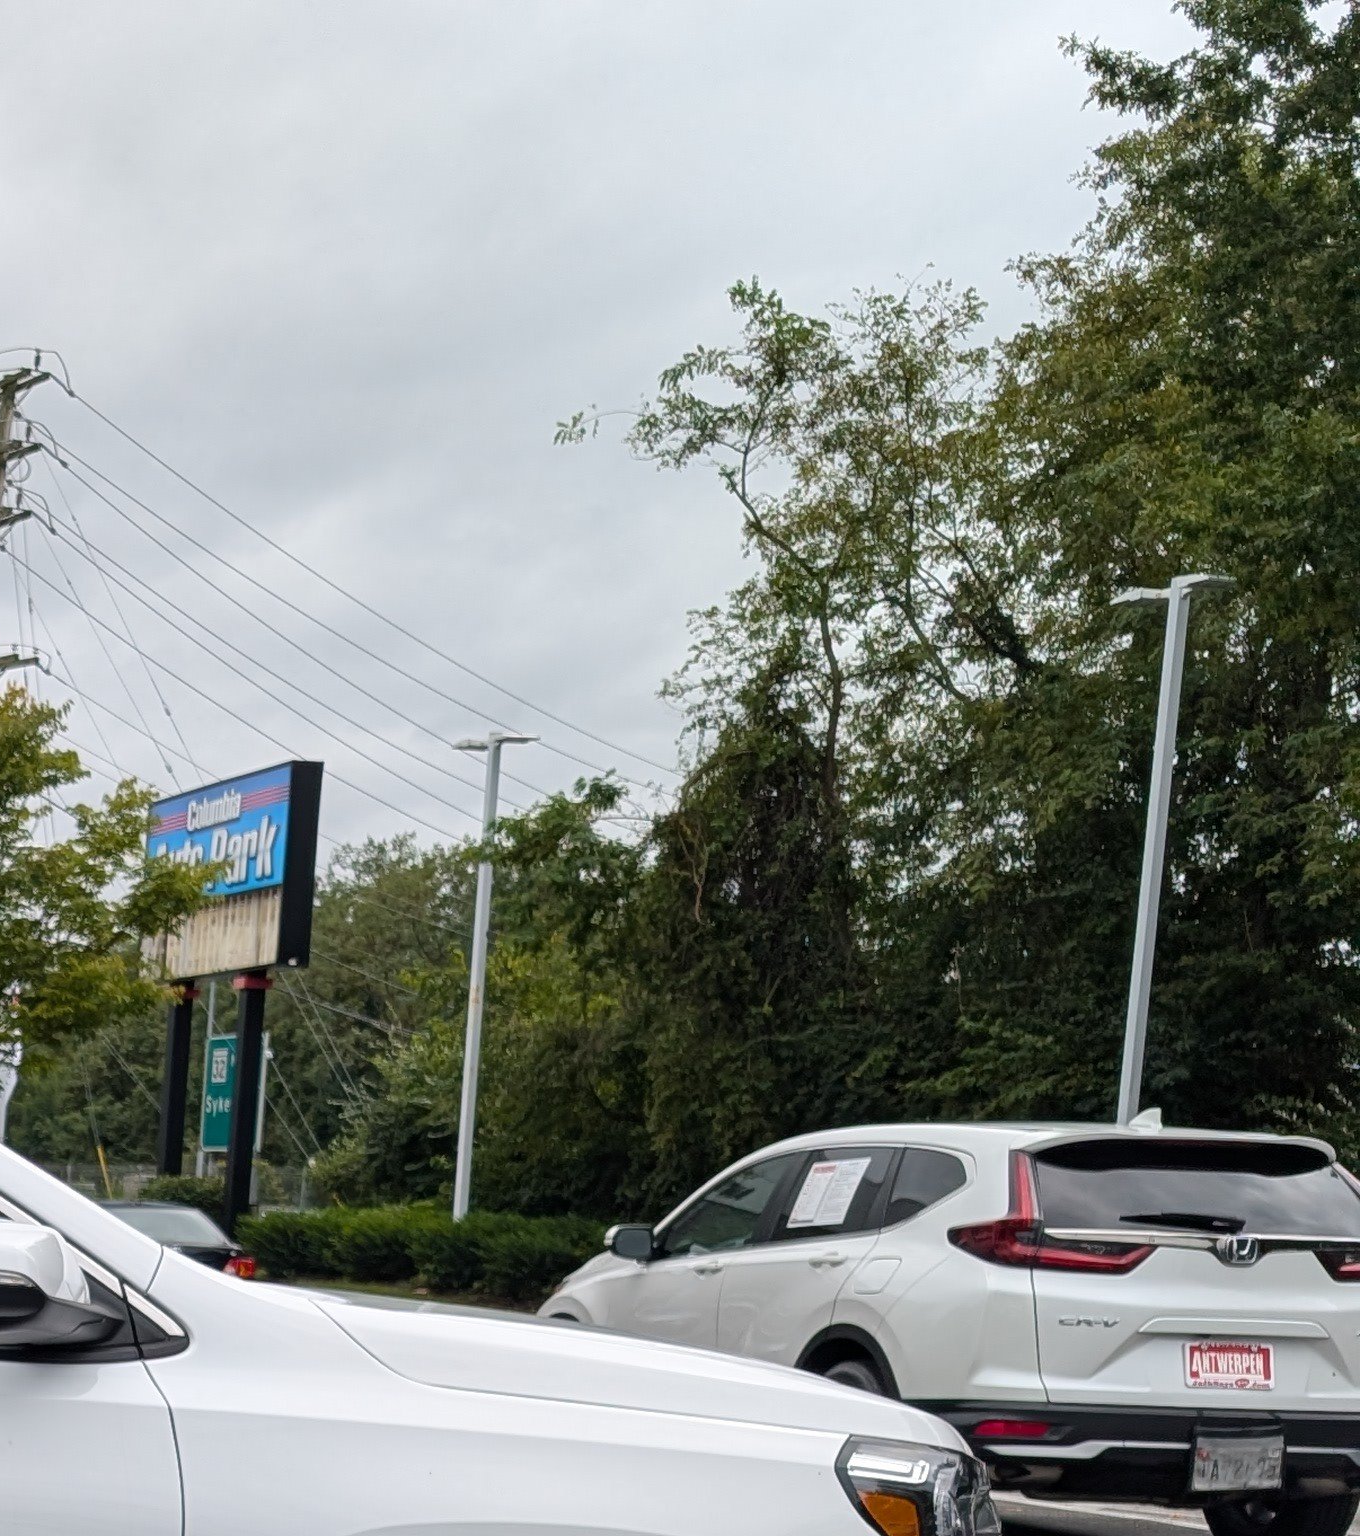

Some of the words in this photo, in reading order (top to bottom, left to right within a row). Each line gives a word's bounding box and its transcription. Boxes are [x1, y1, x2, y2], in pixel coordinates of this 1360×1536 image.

[186, 789, 242, 832] Columbia
[206, 815, 279, 891] Park
[205, 1095, 231, 1118] Syke
[1058, 1314, 1120, 1328] CR-V
[1191, 1350, 1264, 1377] ANTWERPEN
